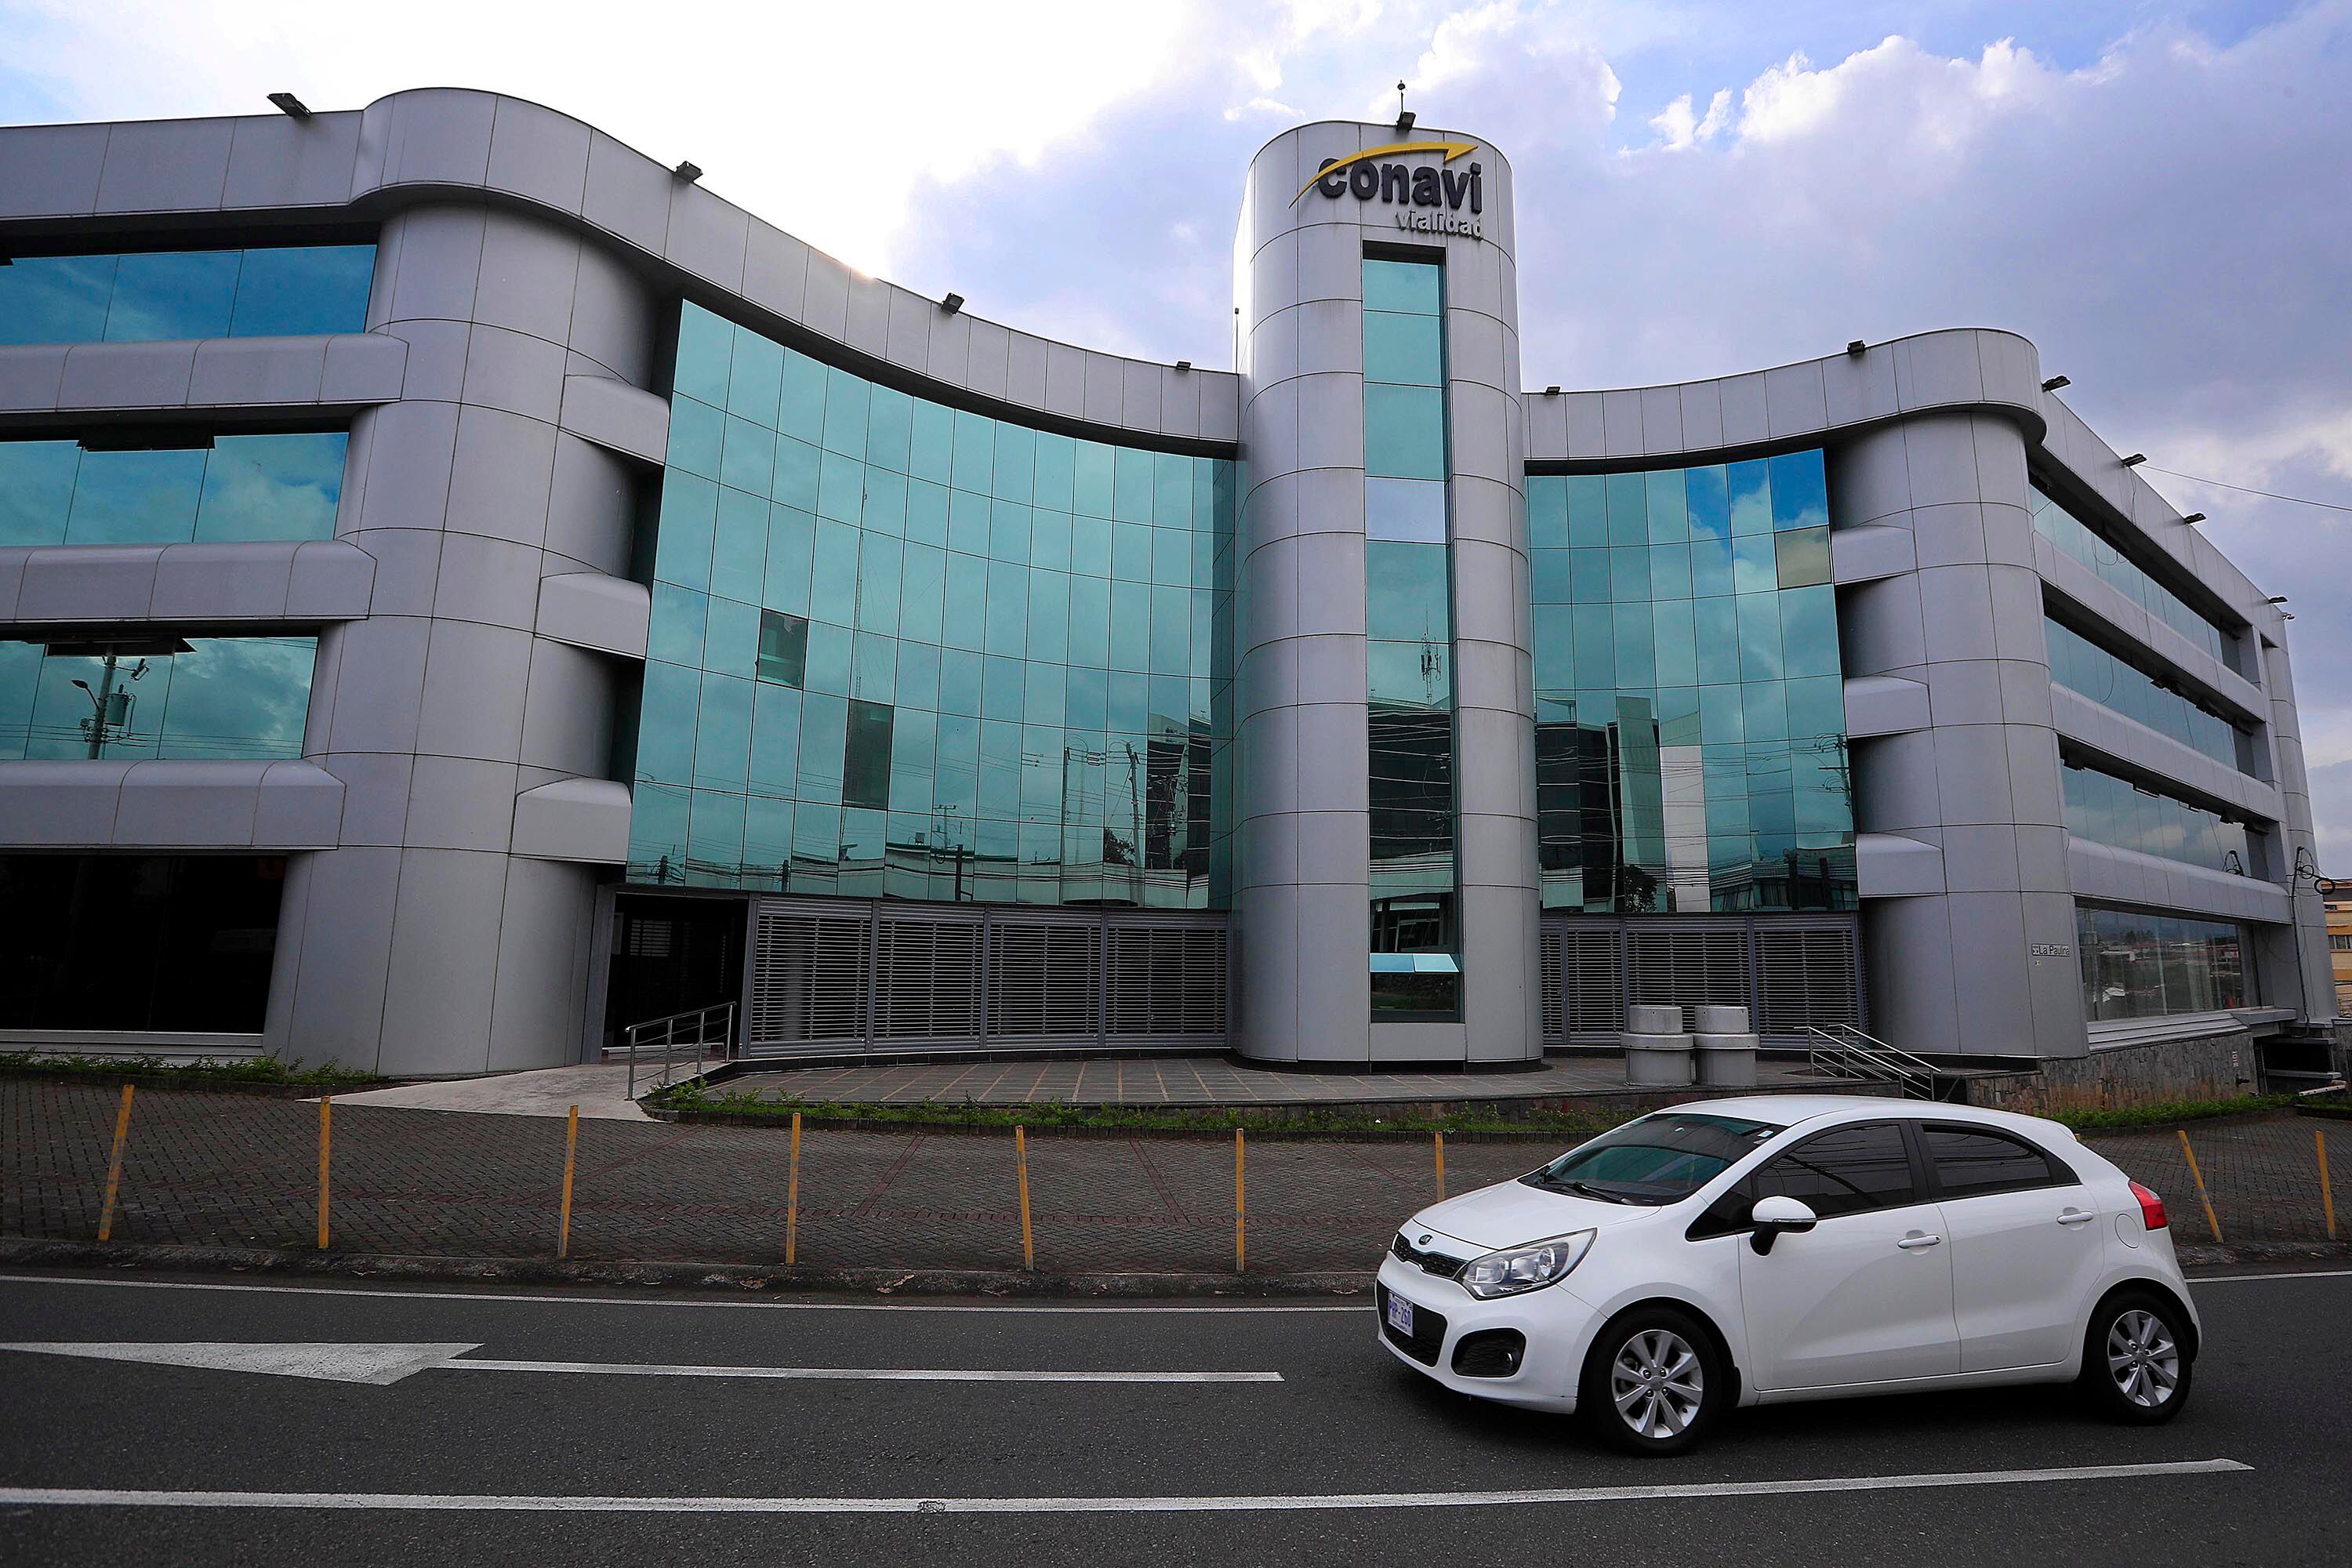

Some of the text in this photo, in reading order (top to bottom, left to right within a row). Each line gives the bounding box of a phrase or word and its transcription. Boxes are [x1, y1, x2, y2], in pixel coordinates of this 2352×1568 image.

[1317, 158, 1482, 214] conavi
[1396, 209, 1482, 239] vialidad
[2039, 946, 2047, 954] La
